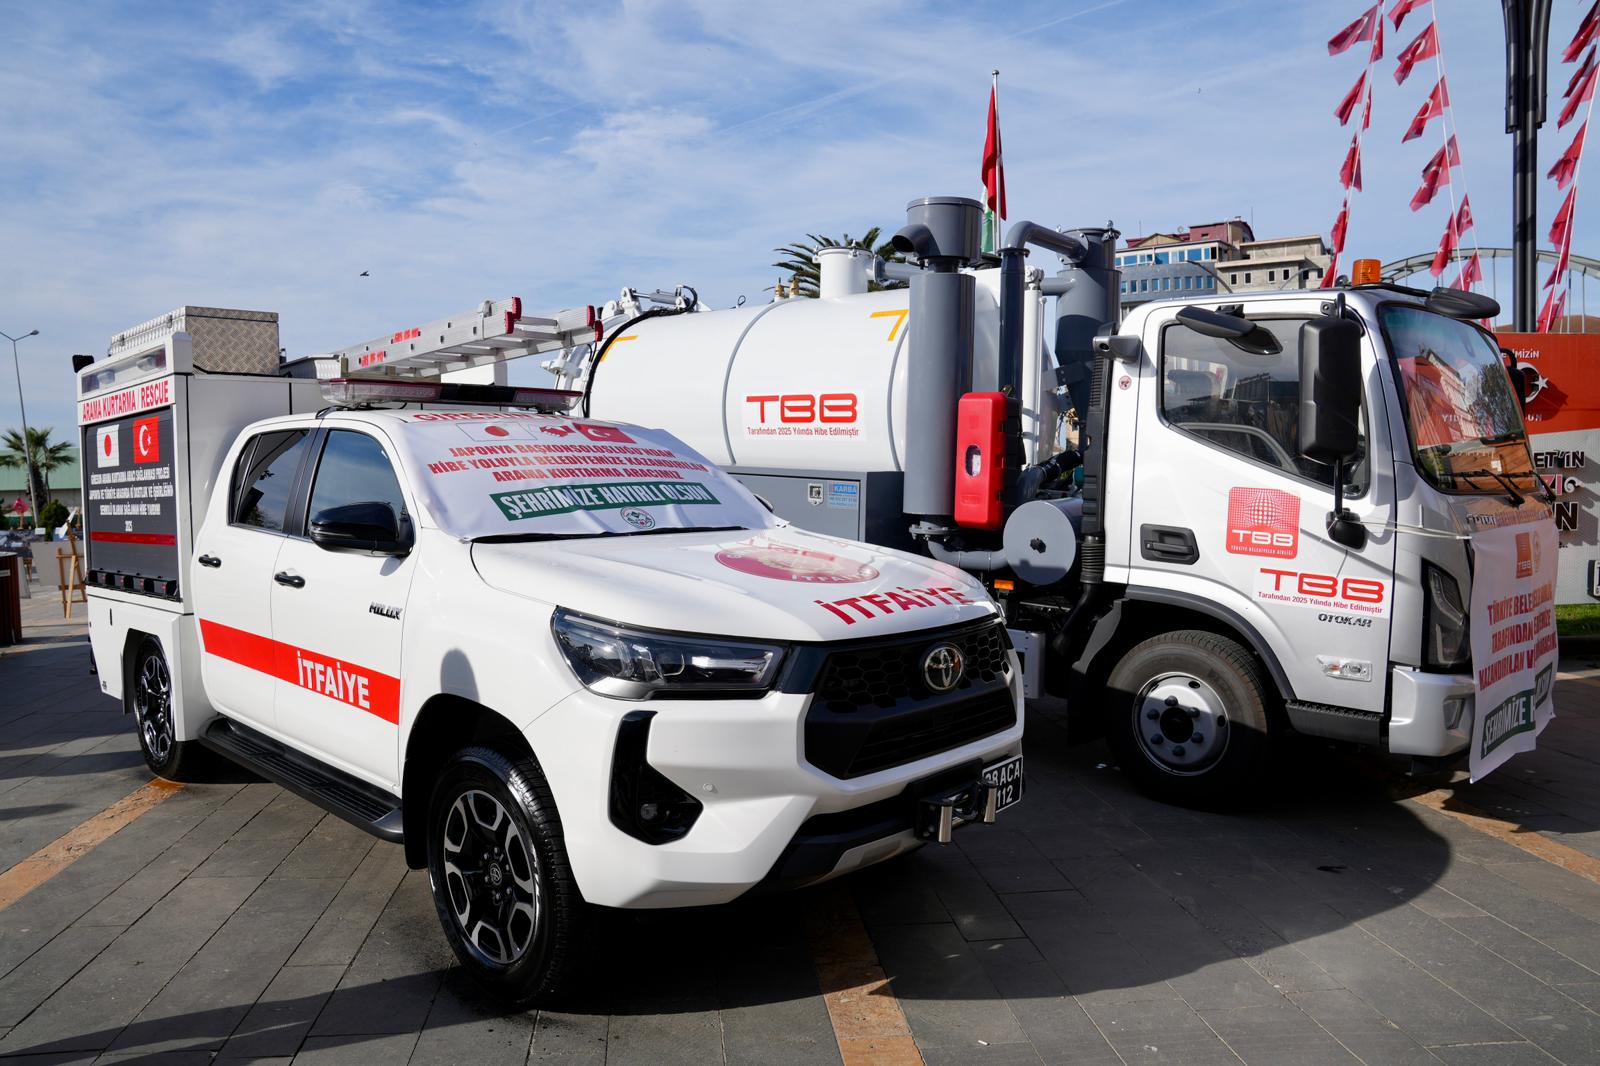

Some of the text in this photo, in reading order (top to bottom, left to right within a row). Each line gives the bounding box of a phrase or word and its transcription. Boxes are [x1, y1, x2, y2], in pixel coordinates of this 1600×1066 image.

[83, 400, 102, 422] ARAMA
[103, 390, 136, 418] KURTARMA
[140, 380, 168, 408] RESCUE
[746, 393, 858, 423] TBB
[748, 426, 859, 438] Tarafından 2025 Yılında Hibe Edilmiştir
[449, 445, 516, 458] JAPONYA
[428, 454, 710, 474] HİBE YOLUYLA BELEDİYEMİZE KAZANDIRILAN
[492, 468, 684, 482] ARAMA KURTARMA ARACIMIZ
[500, 484, 713, 518] ŞEHRİMİZE HAYIRLI OLSUN
[1232, 529, 1294, 547] TBB
[1260, 568, 1384, 604] TBB
[814, 586, 974, 625] İTFAİYE
[1258, 591, 1383, 614] Tarafından 2025 Yılında Hibe Edilmiştir
[1318, 613, 1373, 628] OTOKAR
[297, 650, 370, 709] İTFAİYE
[998, 785, 1013, 808] 112
